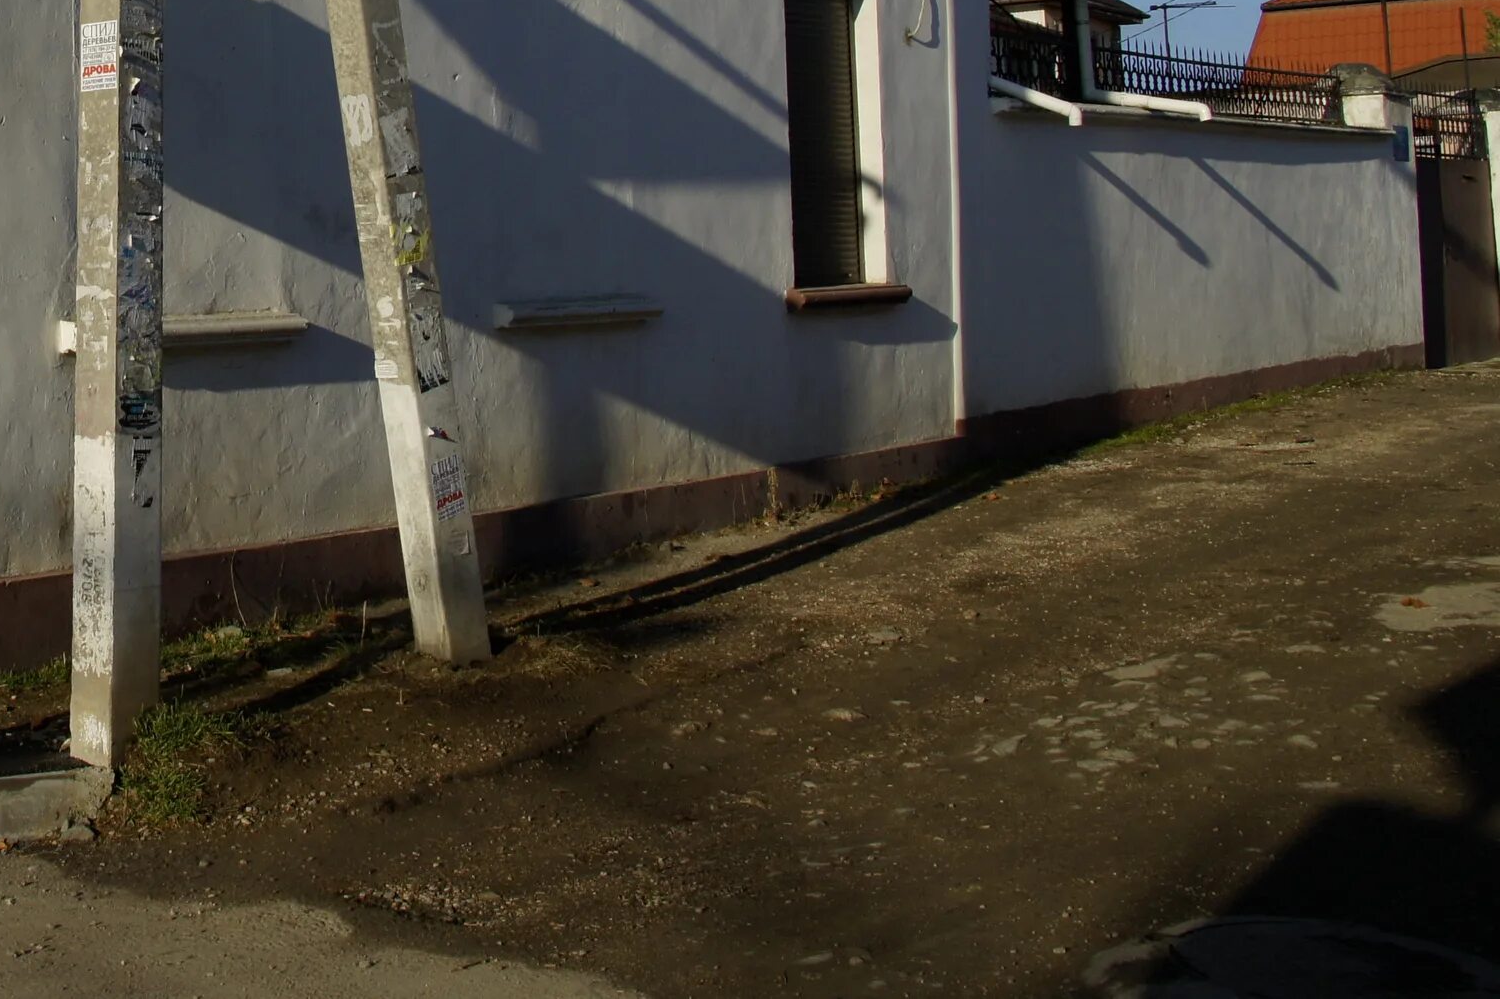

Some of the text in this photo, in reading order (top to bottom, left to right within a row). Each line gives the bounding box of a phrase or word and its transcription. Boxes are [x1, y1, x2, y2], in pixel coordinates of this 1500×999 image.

[82, 22, 116, 39] СПИЛ
[82, 36, 116, 47] ДЕРЕВЬЕВ
[82, 64, 116, 78] ДРОВА
